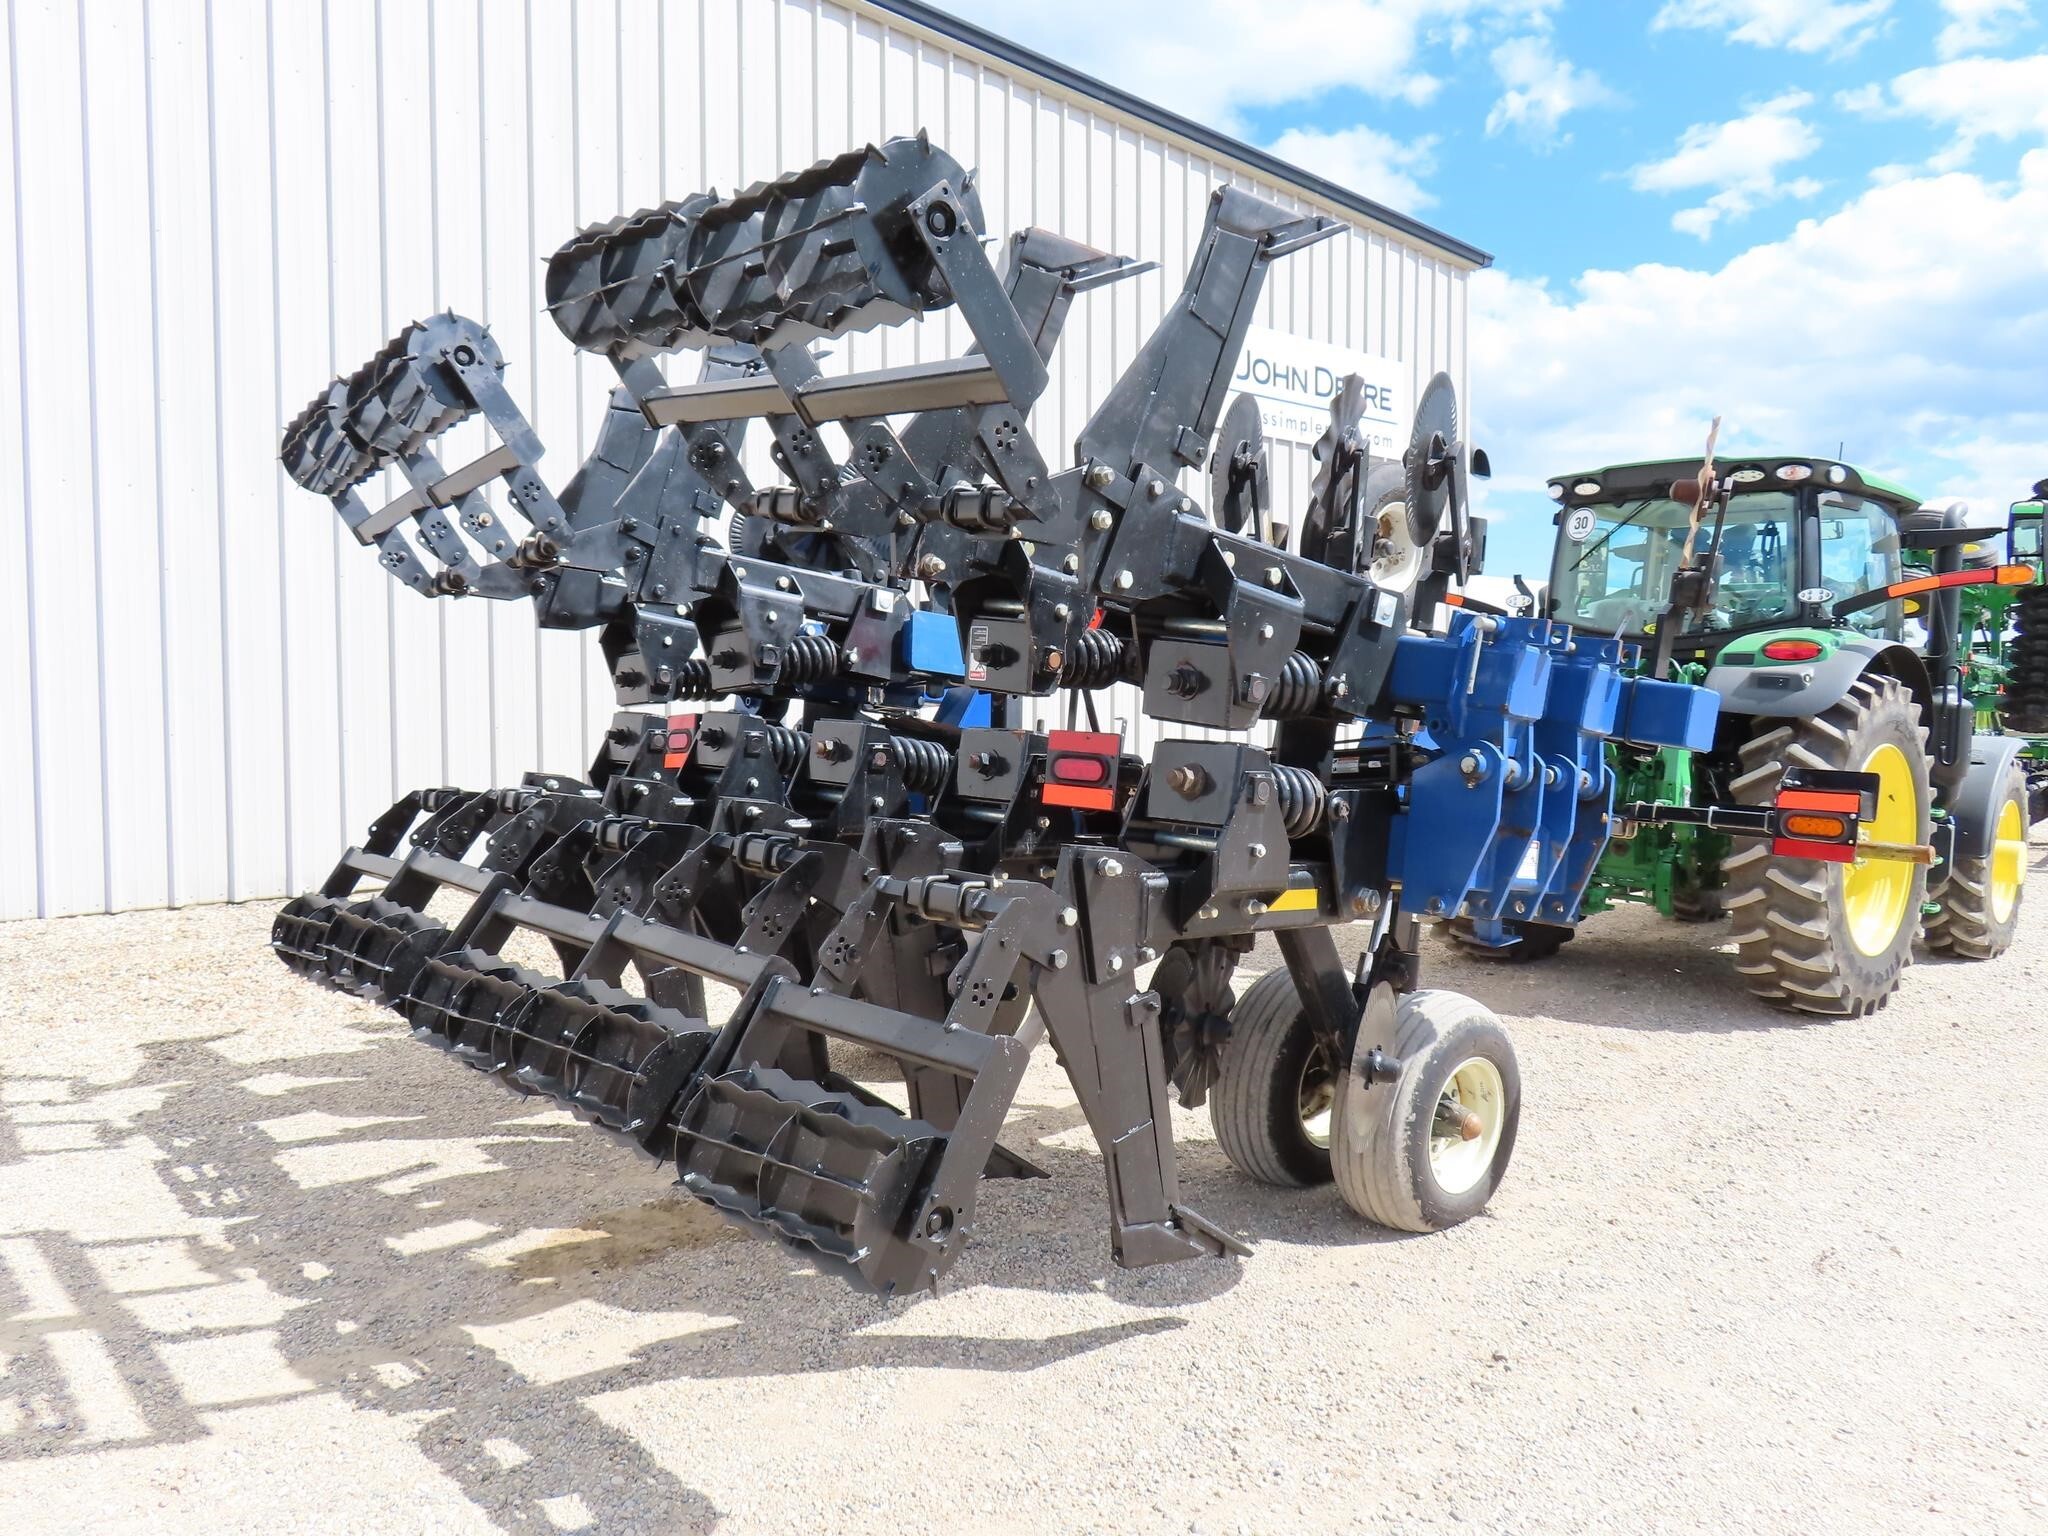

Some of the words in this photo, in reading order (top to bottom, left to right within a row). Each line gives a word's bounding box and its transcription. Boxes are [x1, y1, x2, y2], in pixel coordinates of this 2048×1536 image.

[1236, 349, 1308, 394] JOHN
[1314, 366, 1393, 411] DERE
[1574, 516, 1589, 530] 30
